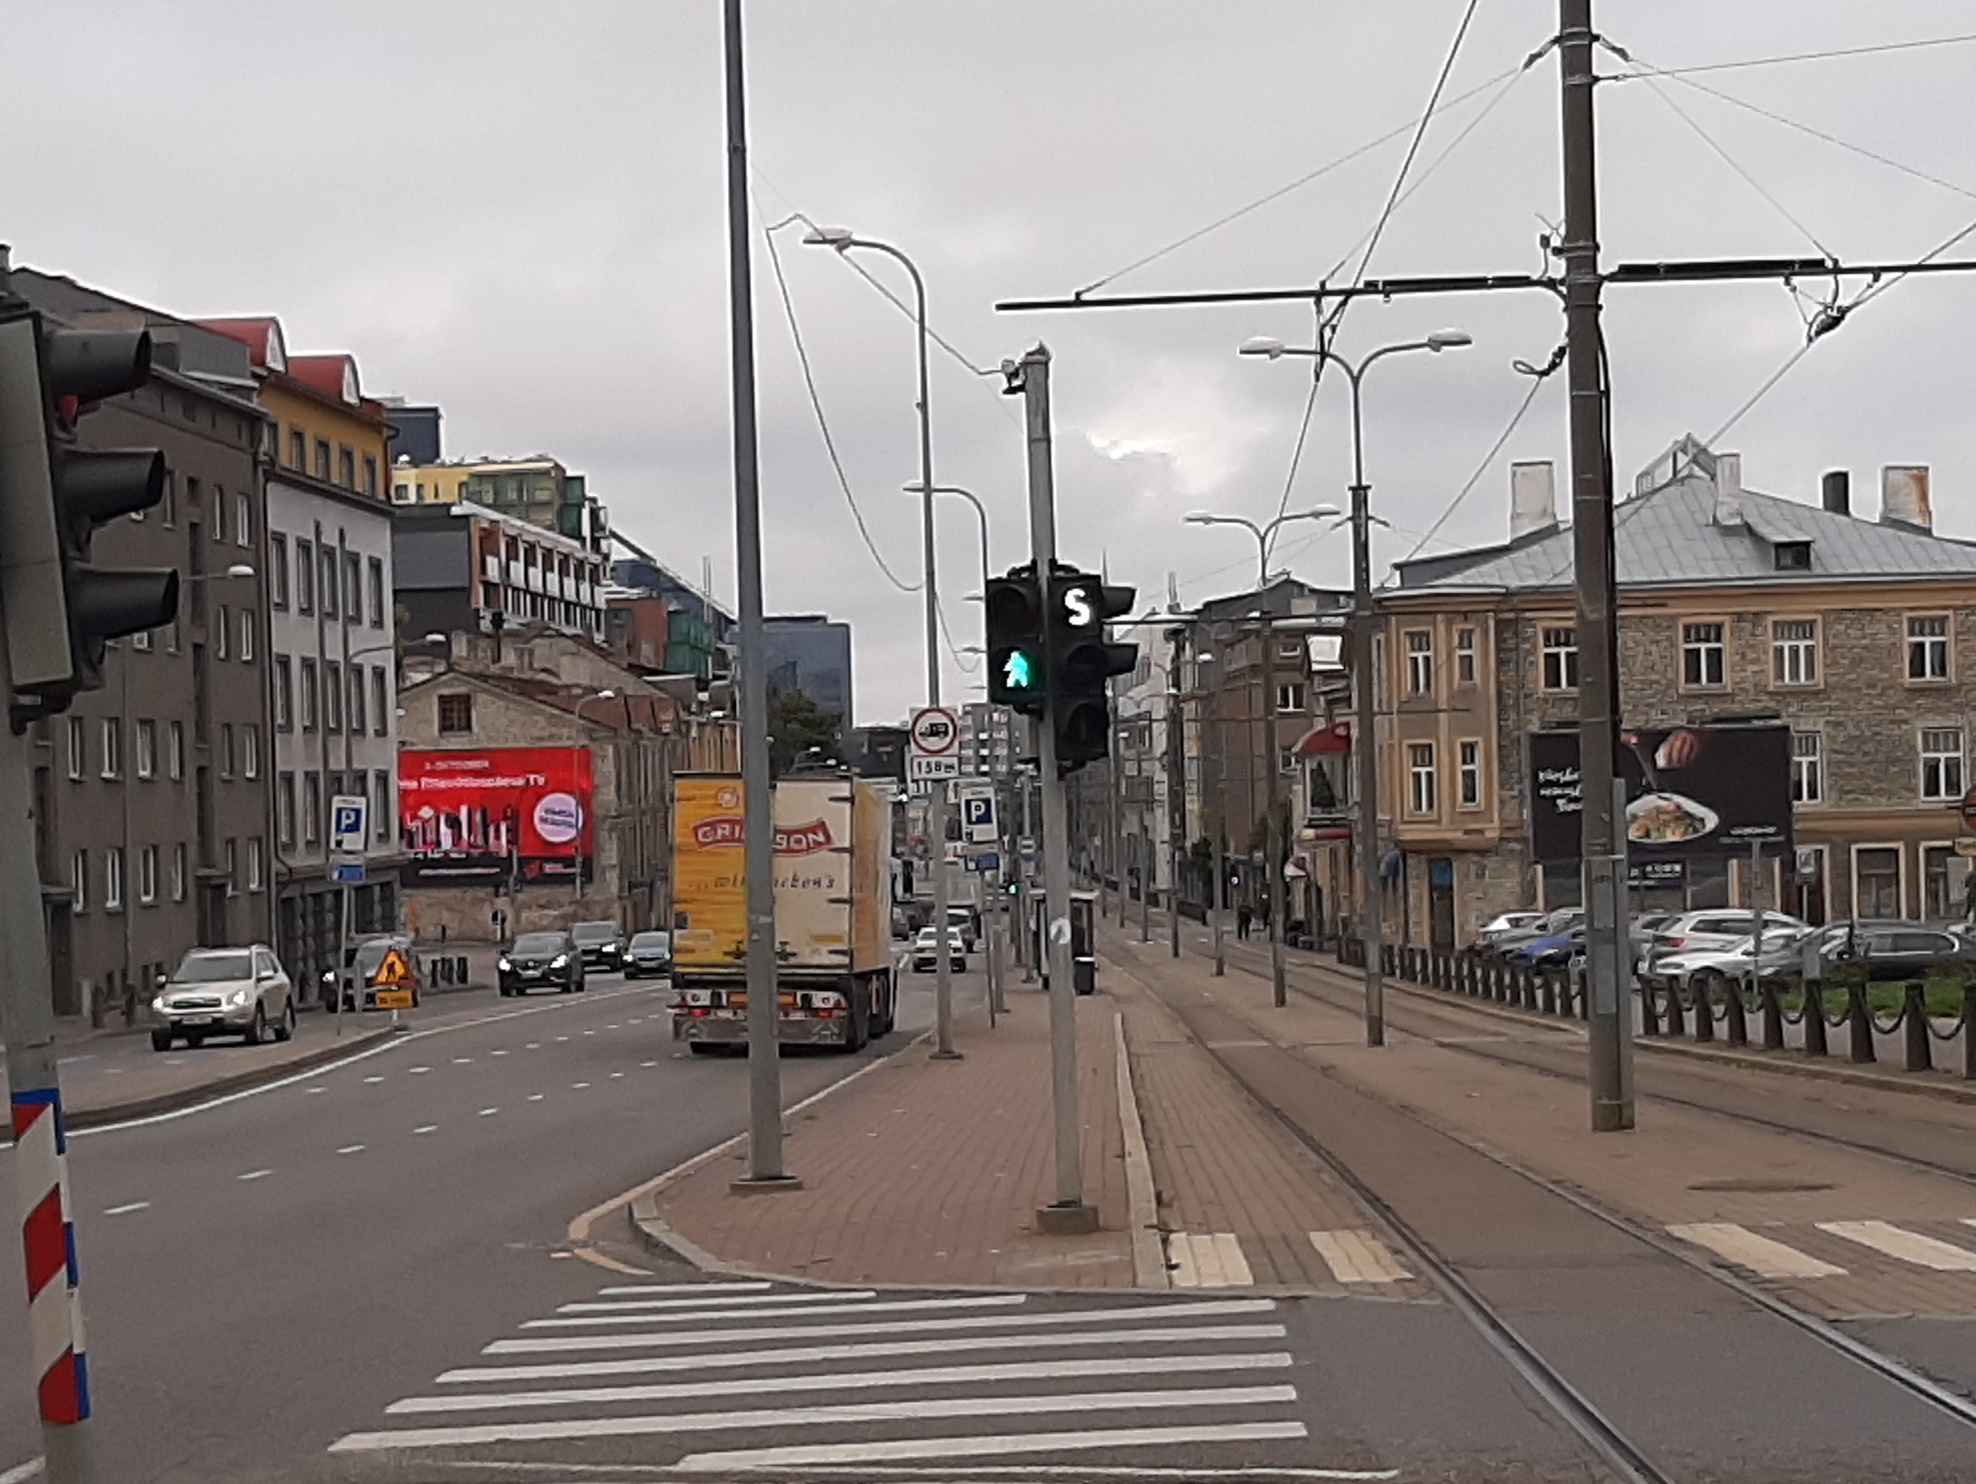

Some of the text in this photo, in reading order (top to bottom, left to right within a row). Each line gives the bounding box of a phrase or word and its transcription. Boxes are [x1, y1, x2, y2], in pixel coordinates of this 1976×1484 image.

[1065, 588, 1090, 625] S
[341, 810, 356, 830] P
[971, 801, 985, 821] P
